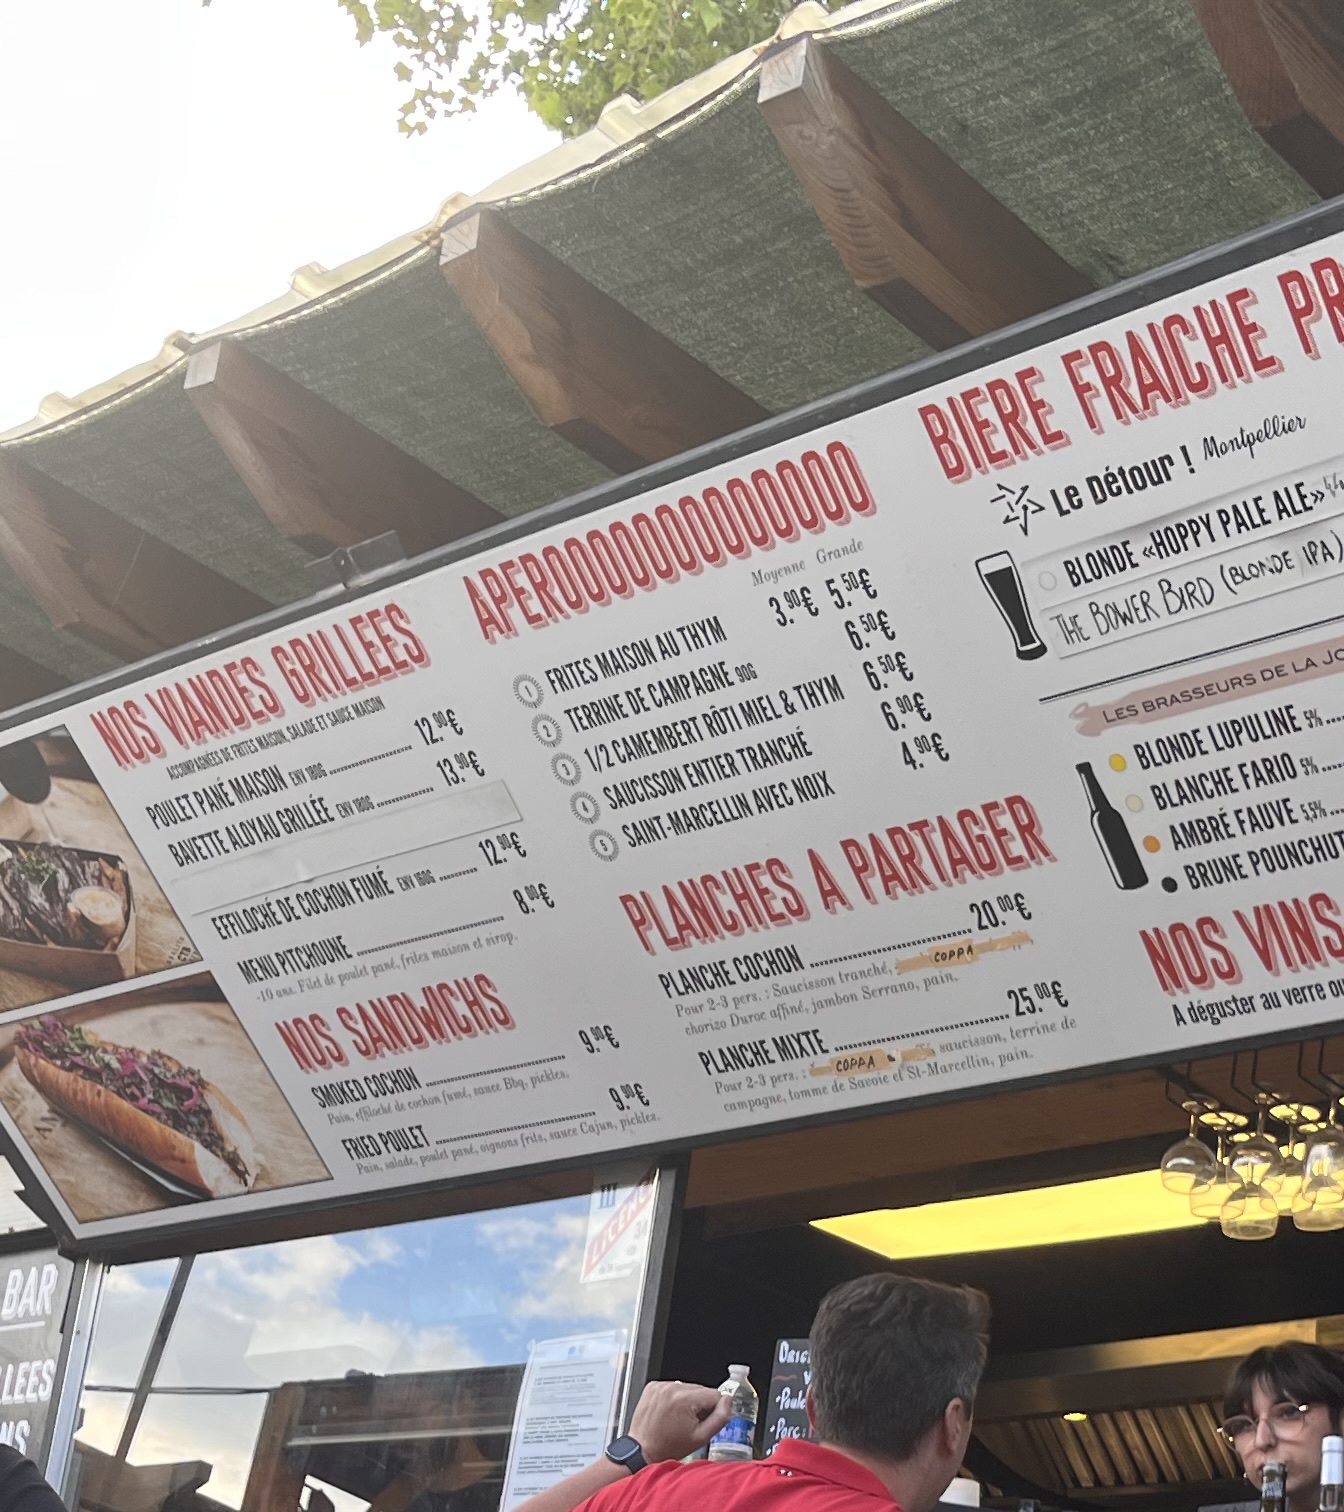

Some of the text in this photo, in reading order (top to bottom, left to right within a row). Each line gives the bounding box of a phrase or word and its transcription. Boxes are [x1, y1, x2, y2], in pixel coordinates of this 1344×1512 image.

[917, 366, 1071, 484] BIERE
[1060, 287, 1284, 435] FRAICHE
[1085, 454, 1174, 505] Détour
[1179, 444, 1195, 473] !
[1202, 414, 1305, 460] Montpellier
[750, 538, 862, 586] Moyenne Grande
[1062, 539, 1139, 587] BLONDE
[1142, 512, 1215, 559] «HOPPY
[1216, 495, 1271, 537] PALE
[544, 568, 877, 694] FRITES MAISON AU THYM 3.90€ 5.50€
[1049, 613, 1090, 644] THE
[1088, 589, 1160, 635] BOWER
[1157, 576, 1214, 615] BIRD
[89, 602, 430, 770] NOS VIANDES GRILLEES
[563, 609, 895, 732] TERRINE DE CAMPAGNE 6.50€
[583, 651, 913, 772] 1/2 CAMEMBERT RÔTI MIEL & THYM 6.50€
[145, 708, 463, 829] POULET PANÉ MAISON 12.90€
[602, 692, 931, 809] SAUCISSON ENTIER TRANCHÉ 6.90€
[1132, 727, 1209, 770] BLONDE
[1206, 704, 1302, 751] LUPULINE
[1149, 766, 1239, 810] BLANCHE
[1237, 752, 1297, 790] FARIO
[167, 750, 485, 867] BAVETTE ALOYAU GRILLÉE 13.90€
[621, 732, 949, 847] SAINT-MARCELLIN AVEC NOIX 4.90€
[1169, 807, 1236, 850] AMBRÉ
[1233, 797, 1298, 835] FAUVE
[210, 831, 526, 940] EFFILOCHÉ DE COCHON FUMÉ 12.90€
[618, 794, 1057, 956] PLANCHES A PARTAGER
[1183, 853, 1248, 889] BRUNE
[236, 954, 280, 984] MENU
[274, 935, 352, 975] PITCHOUNE
[512, 882, 554, 914] 8.00€
[657, 892, 1032, 998] PLANCHE COCHON 20.00€
[1138, 916, 1242, 996] NOS
[274, 973, 515, 1074] NOS SANDWICHS
[697, 980, 1068, 1075] PLANCHE MIXTE 25.00€
[1171, 1003, 1187, 1026] A
[1187, 994, 1256, 1025] déguster
[1259, 991, 1281, 1010] au
[1281, 982, 1326, 1005] verre
[310, 1024, 619, 1108] SMOKED COCHON 9.90€
[340, 1082, 649, 1160] FRIED POULET 9.90€
[1, 1263, 58, 1321] BAR
